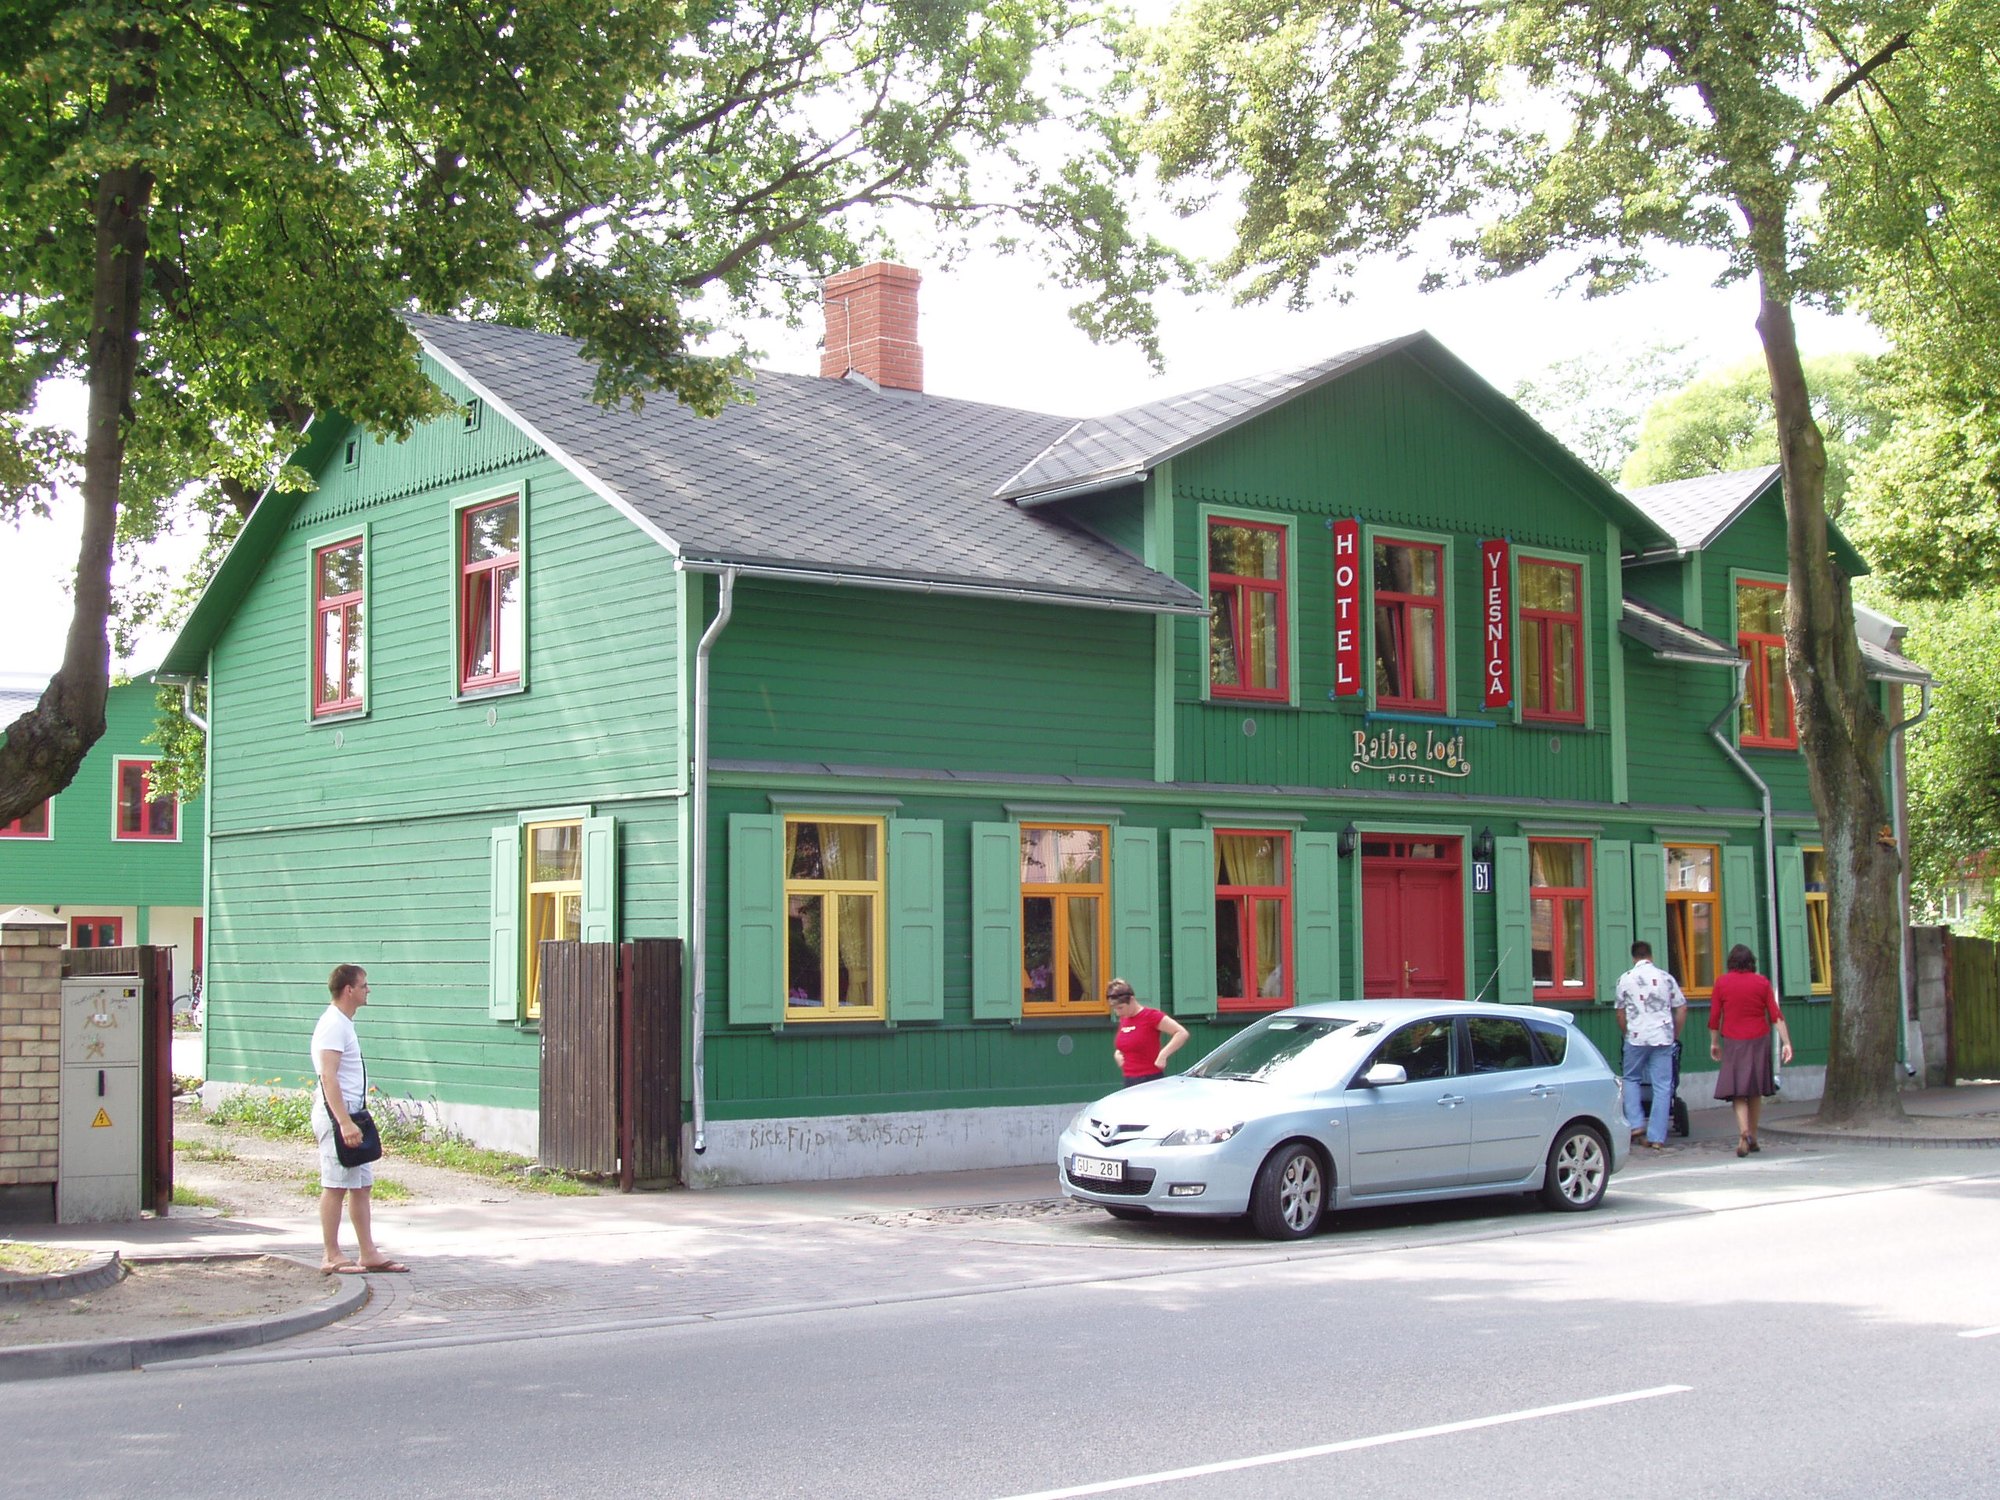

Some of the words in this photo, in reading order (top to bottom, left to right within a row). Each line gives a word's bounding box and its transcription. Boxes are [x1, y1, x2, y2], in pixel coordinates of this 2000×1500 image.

[1336, 533, 1353, 683] HOTEL
[1352, 728, 1417, 763] Raibie
[1426, 730, 1465, 768] logi
[1388, 773, 1435, 784] HOTEL
[1476, 864, 1488, 891] 61
[1100, 1162, 1119, 1177] 281
